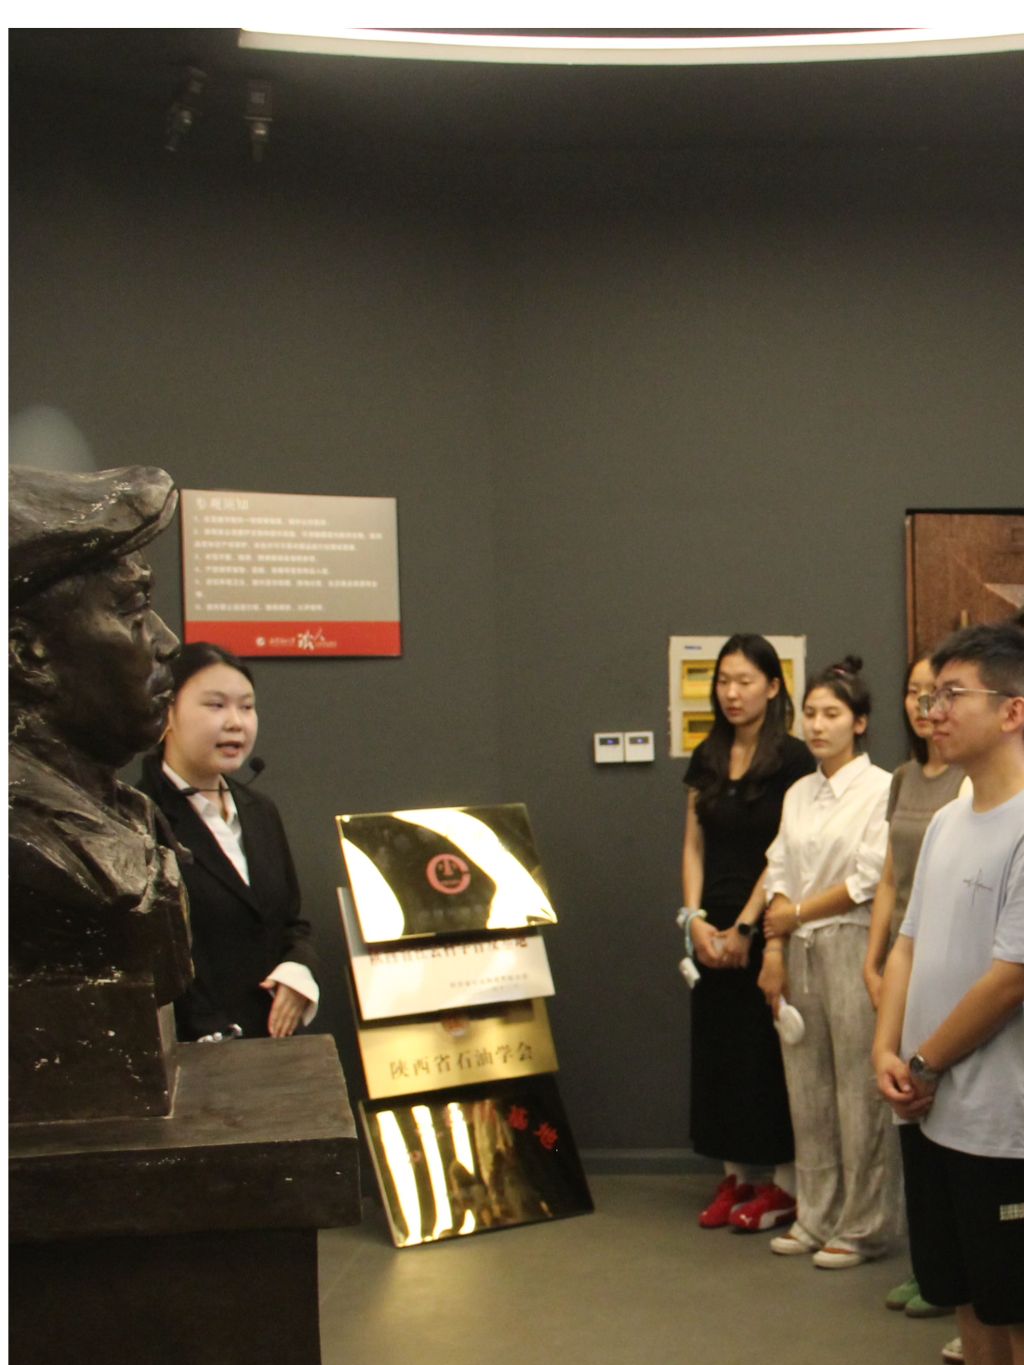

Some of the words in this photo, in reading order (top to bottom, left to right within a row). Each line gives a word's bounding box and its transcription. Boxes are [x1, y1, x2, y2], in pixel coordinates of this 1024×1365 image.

[389, 1041, 534, 1080] 陕西省石油学会
